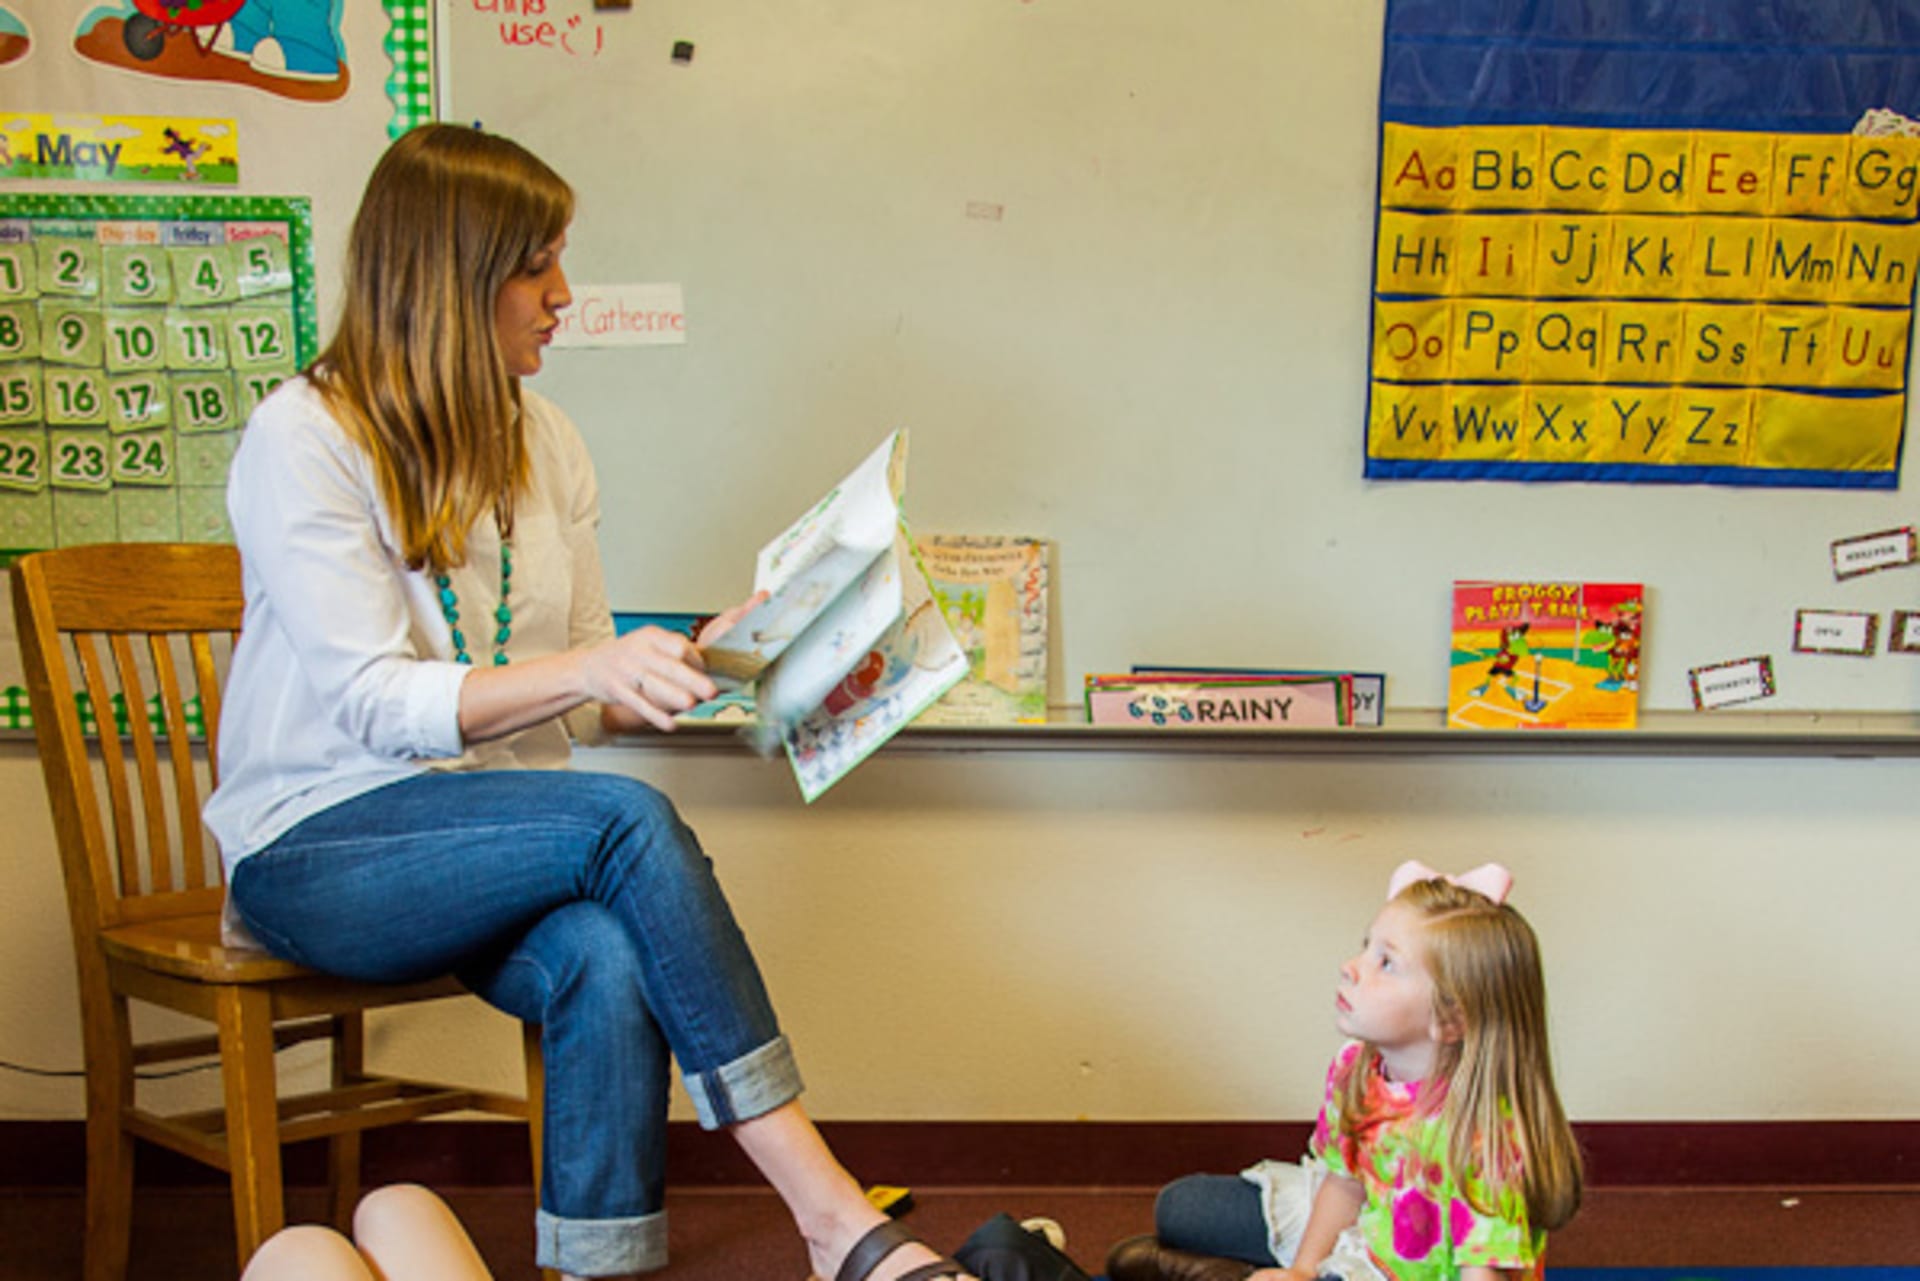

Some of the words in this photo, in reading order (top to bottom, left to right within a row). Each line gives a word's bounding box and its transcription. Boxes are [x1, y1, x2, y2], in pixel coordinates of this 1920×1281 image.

[500, 21, 556, 47] use
[36, 133, 122, 176] May
[1394, 150, 1456, 190] Aa
[1472, 150, 1533, 190] Bb
[1550, 150, 1607, 190] Cc
[1624, 153, 1685, 193] Dd
[1707, 153, 1758, 194] Ee
[1786, 154, 1835, 195] Ff
[1855, 149, 1918, 206] Gg
[58, 251, 80, 283] 2
[128, 259, 150, 292] 3
[195, 260, 219, 291] 4
[248, 249, 271, 278] 5
[1393, 235, 1447, 275] Hh
[1477, 237, 1513, 276] Ii
[1551, 225, 1598, 284] Jj
[1624, 236, 1675, 276] Kk
[1705, 236, 1754, 276] Ll
[1771, 239, 1834, 282] Mm
[1848, 242, 1905, 283] Nn
[0, 315, 20, 348] 8
[61, 318, 84, 350] 9
[114, 325, 155, 359] 10
[181, 325, 213, 358] 11
[238, 322, 280, 356] 12
[1386, 323, 1444, 362] Oo
[1464, 311, 1520, 370] Pp
[1537, 313, 1598, 368] Qq
[1617, 323, 1671, 363] Rr
[1696, 323, 1747, 365] Ss
[1778, 326, 1819, 365] Tt
[1842, 327, 1895, 368] Uu
[56, 380, 95, 413] 16
[115, 383, 151, 418] 17
[182, 386, 223, 421] 18
[1392, 404, 1438, 441] Vv
[1453, 404, 1519, 442] Ww
[1534, 403, 1588, 442] Xx
[1611, 400, 1666, 454] Yy
[1686, 406, 1739, 446] Zz
[0, 441, 36, 478] 22
[60, 444, 104, 477] 23
[120, 439, 165, 472] 24
[1463, 601, 1521, 625] PLAYS
[1491, 582, 1579, 602] FROGGY
[1196, 697, 1293, 722] RAINY
